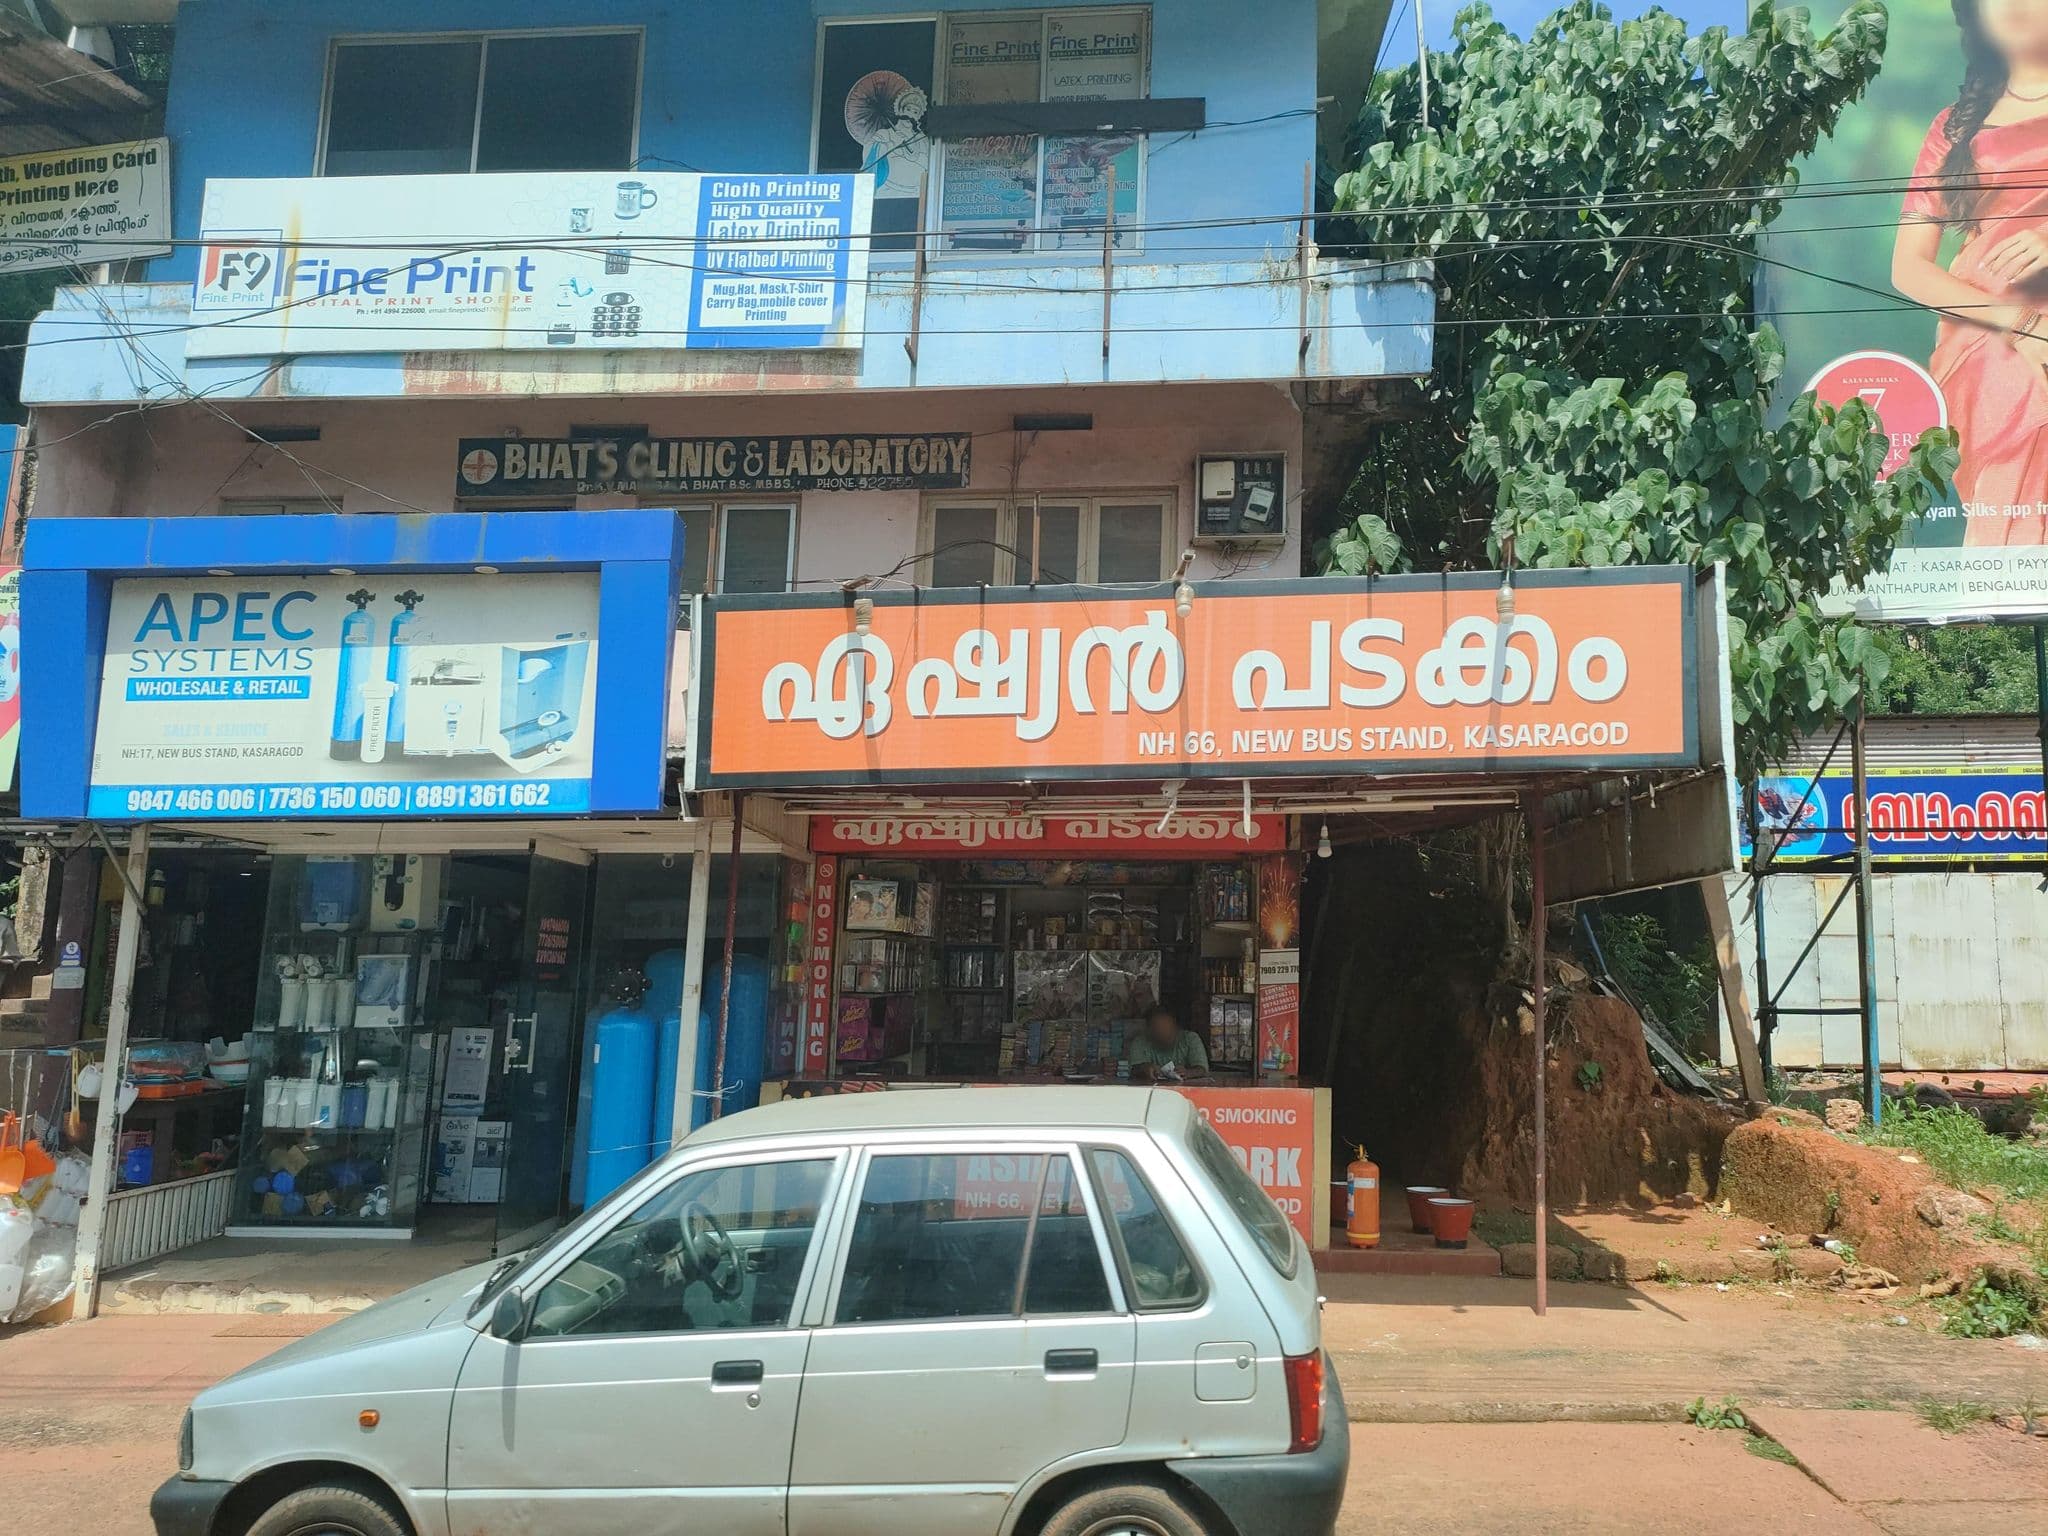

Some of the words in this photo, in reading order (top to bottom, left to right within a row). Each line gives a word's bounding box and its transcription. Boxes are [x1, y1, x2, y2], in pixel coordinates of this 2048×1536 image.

[952, 42, 988, 56] Fine
[996, 40, 1040, 54] Print
[1050, 37, 1087, 49] Fine
[1094, 33, 1136, 48] Print
[1054, 74, 1082, 86] LATEX
[1087, 72, 1132, 85] PRINTING
[24, 157, 107, 180] Wedding
[112, 148, 157, 169] Card
[981, 159, 1024, 168] PRINTING
[986, 169, 1029, 178] PRINTING
[0, 185, 70, 207] Printing
[75, 179, 118, 197] Here
[712, 182, 760, 198] Cloth
[766, 181, 841, 199] Printing
[711, 203, 752, 219] High
[758, 202, 824, 217] Quality
[83, 224, 91, 235] &
[710, 221, 759, 239] Latex
[766, 220, 838, 248] Printing
[707, 251, 725, 269] UV
[728, 251, 777, 268] Flatbed
[781, 251, 835, 270] Printing
[284, 258, 389, 296] Fine
[406, 256, 536, 294] Print
[201, 293, 227, 303] Fine
[232, 292, 265, 303] Print
[375, 297, 434, 306] PRINT
[455, 295, 532, 305] SHOPPE
[707, 297, 735, 309] Carry
[800, 297, 828, 306] cover
[745, 309, 787, 321] Printing
[628, 441, 736, 479] CLINIC
[743, 441, 764, 477] &
[768, 437, 968, 477] LABORATORY
[693, 480, 726, 490] BHAT
[1961, 502, 1997, 518] Silks
[2003, 504, 2031, 518] app
[1921, 560, 2003, 572] KASARAGOD
[1968, 580, 2048, 592] BENGALURU
[133, 590, 317, 643] APEC
[129, 647, 313, 673] SYSTEMS
[761, 609, 1186, 741] ഏഷ്യൻ
[1232, 614, 1628, 710] പടക്കം
[135, 680, 228, 696] WHOLESALE
[233, 681, 245, 695] &
[248, 679, 302, 694] RETAIL
[1138, 730, 1176, 755] NH
[1182, 730, 1223, 757] 66,
[1232, 729, 1294, 753] NEW
[1302, 727, 1353, 752] BUS
[1360, 725, 1455, 753] STAND,
[1464, 721, 1630, 749] KASARAGOD
[121, 748, 154, 760] NH:17,
[157, 748, 179, 758] NEW
[182, 748, 201, 758] BUS
[204, 747, 240, 759] STAND,
[242, 746, 304, 757] KASARAGOD
[128, 790, 173, 811] 9847
[175, 790, 213, 810] 466
[216, 789, 254, 810] 006
[269, 787, 315, 808] 7736
[319, 786, 356, 808] 150
[360, 786, 401, 808] 060
[415, 785, 466, 807] 8891
[469, 785, 506, 806] 361
[509, 783, 550, 806] 662
[817, 885, 832, 919] NO
[810, 927, 831, 1057] SMOKING
[1215, 1108, 1297, 1124] SMOKING
[965, 1191, 992, 1208] NH
[998, 1192, 1024, 1210] 66,
